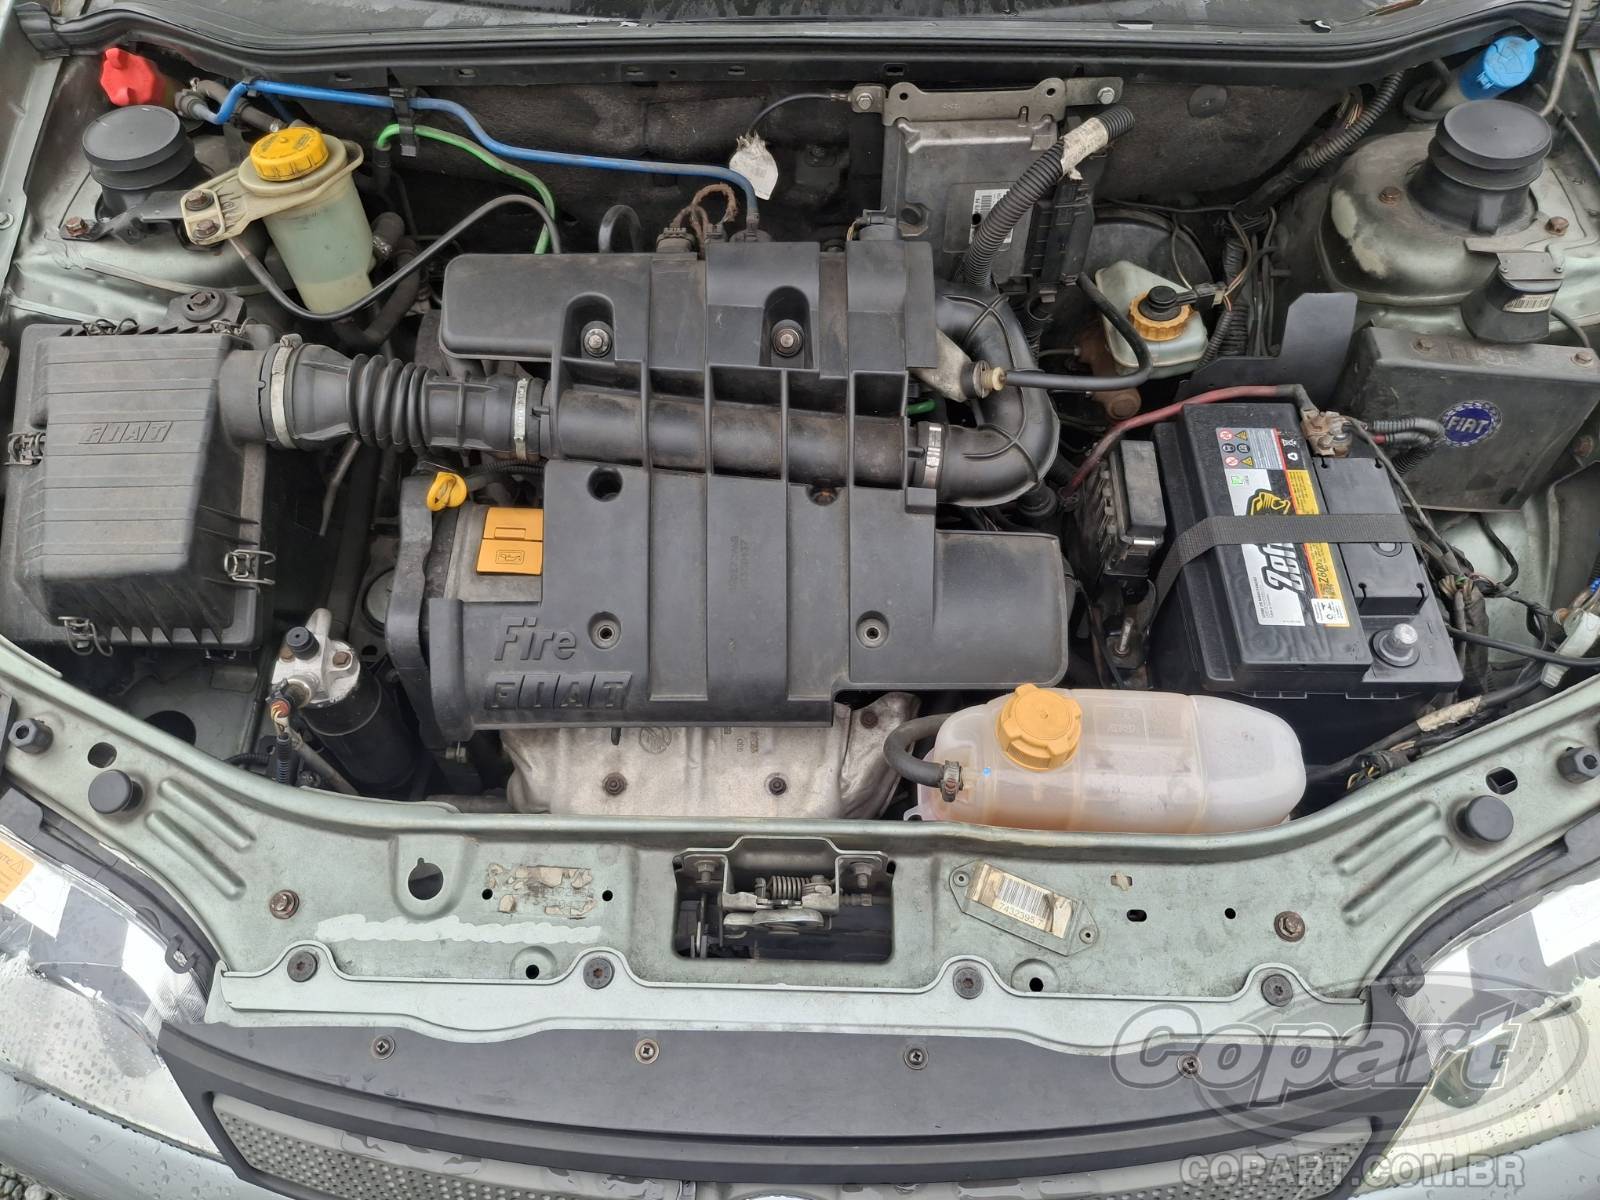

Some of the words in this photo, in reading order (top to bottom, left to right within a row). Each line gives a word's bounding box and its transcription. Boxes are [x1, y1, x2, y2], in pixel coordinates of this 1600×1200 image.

[82, 421, 171, 443] FIAT
[1446, 415, 1490, 434] FIAT
[494, 616, 578, 662] Fire
[488, 677, 629, 709] FIAT
